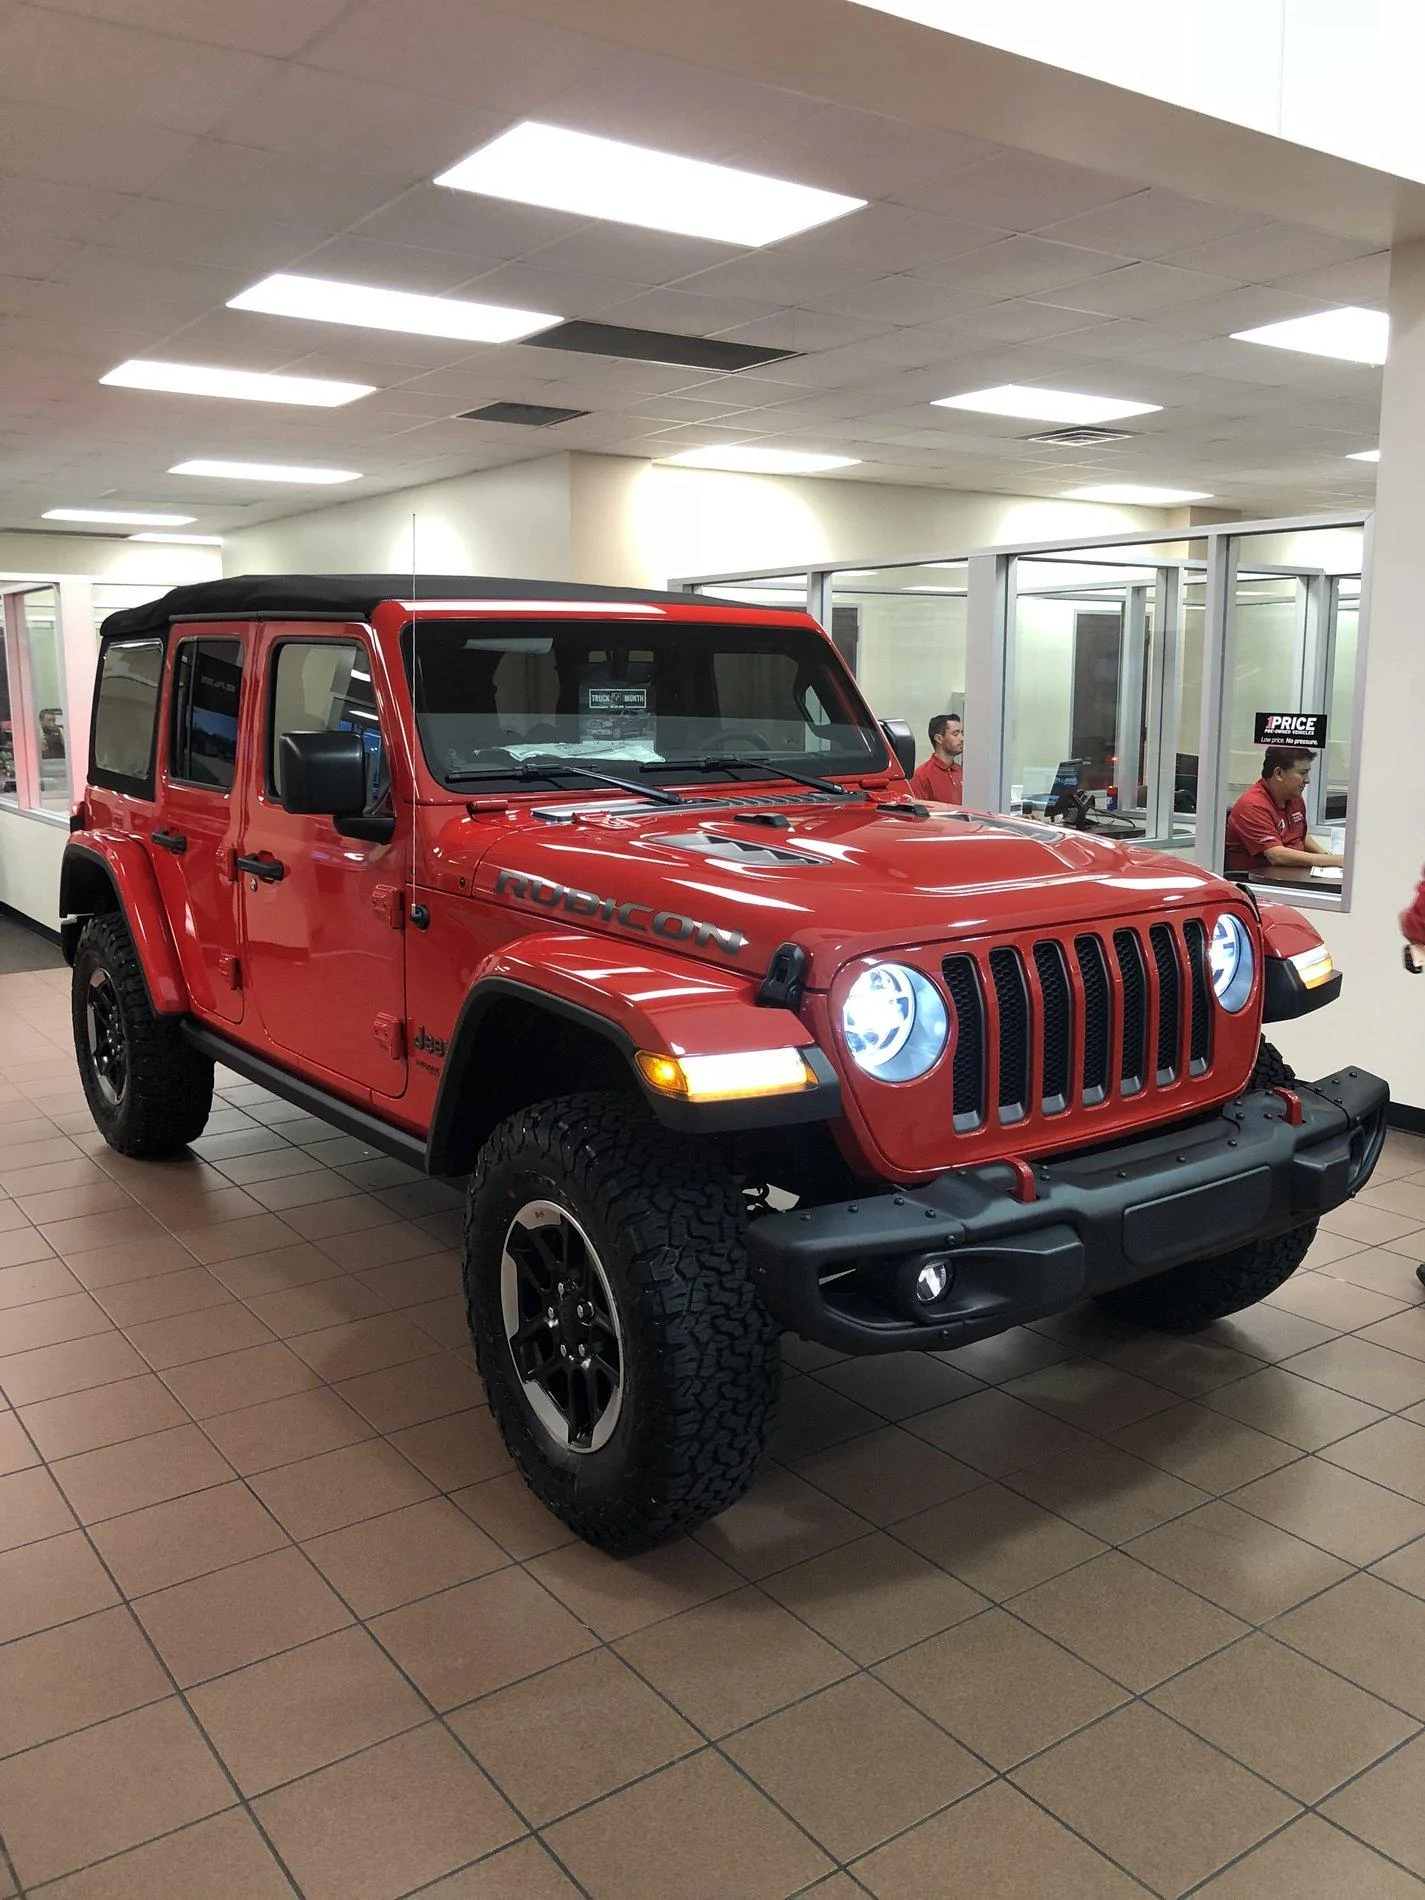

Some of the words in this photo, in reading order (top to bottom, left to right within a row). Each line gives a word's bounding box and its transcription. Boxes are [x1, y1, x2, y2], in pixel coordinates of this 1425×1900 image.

[592, 695, 610, 703] TRUCK
[624, 695, 644, 703] MONTH
[494, 870, 744, 955] RUBICON
